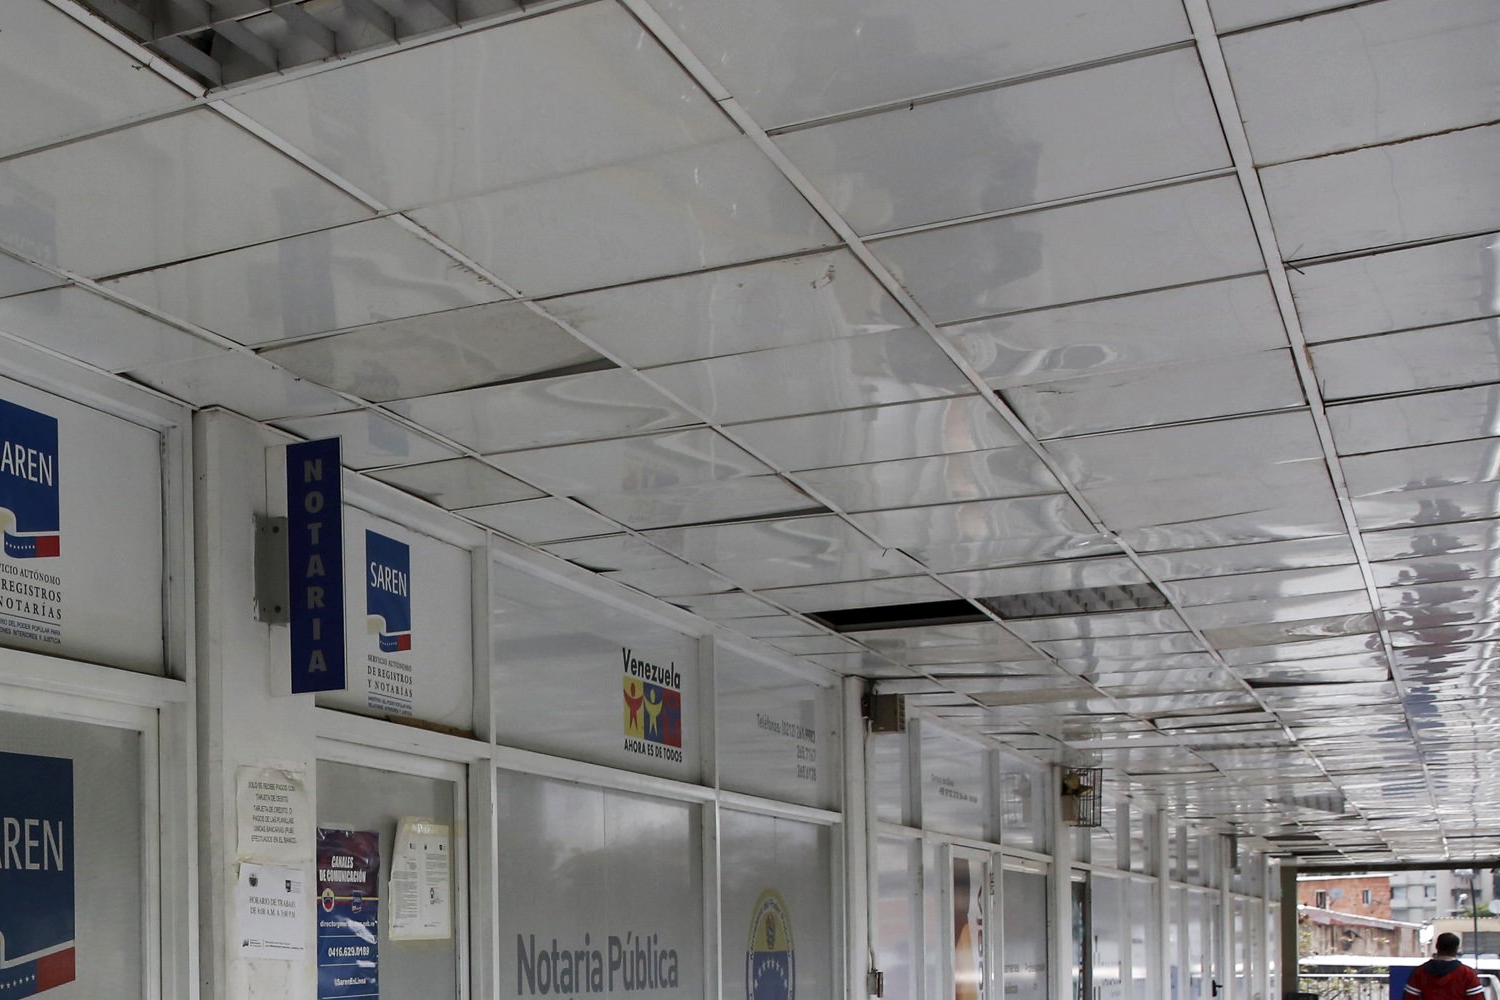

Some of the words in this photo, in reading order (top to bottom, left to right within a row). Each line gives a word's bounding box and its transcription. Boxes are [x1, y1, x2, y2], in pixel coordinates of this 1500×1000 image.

[19, 568, 61, 586] AUTÓNOMO
[304, 458, 327, 673] NOTARIA
[1, 578, 61, 603] REGISTROS
[370, 561, 407, 598] SAREN
[367, 666, 376, 676] DE
[377, 668, 412, 686] REGISTROS
[622, 647, 681, 691] Venezuela
[624, 739, 646, 755] AHORA
[647, 744, 655, 757] ES
[655, 747, 663, 758] DE
[663, 748, 682, 763] TODOS
[331, 855, 354, 870] CANALES
[517, 933, 603, 996] Notaria
[608, 931, 678, 992] Pública
